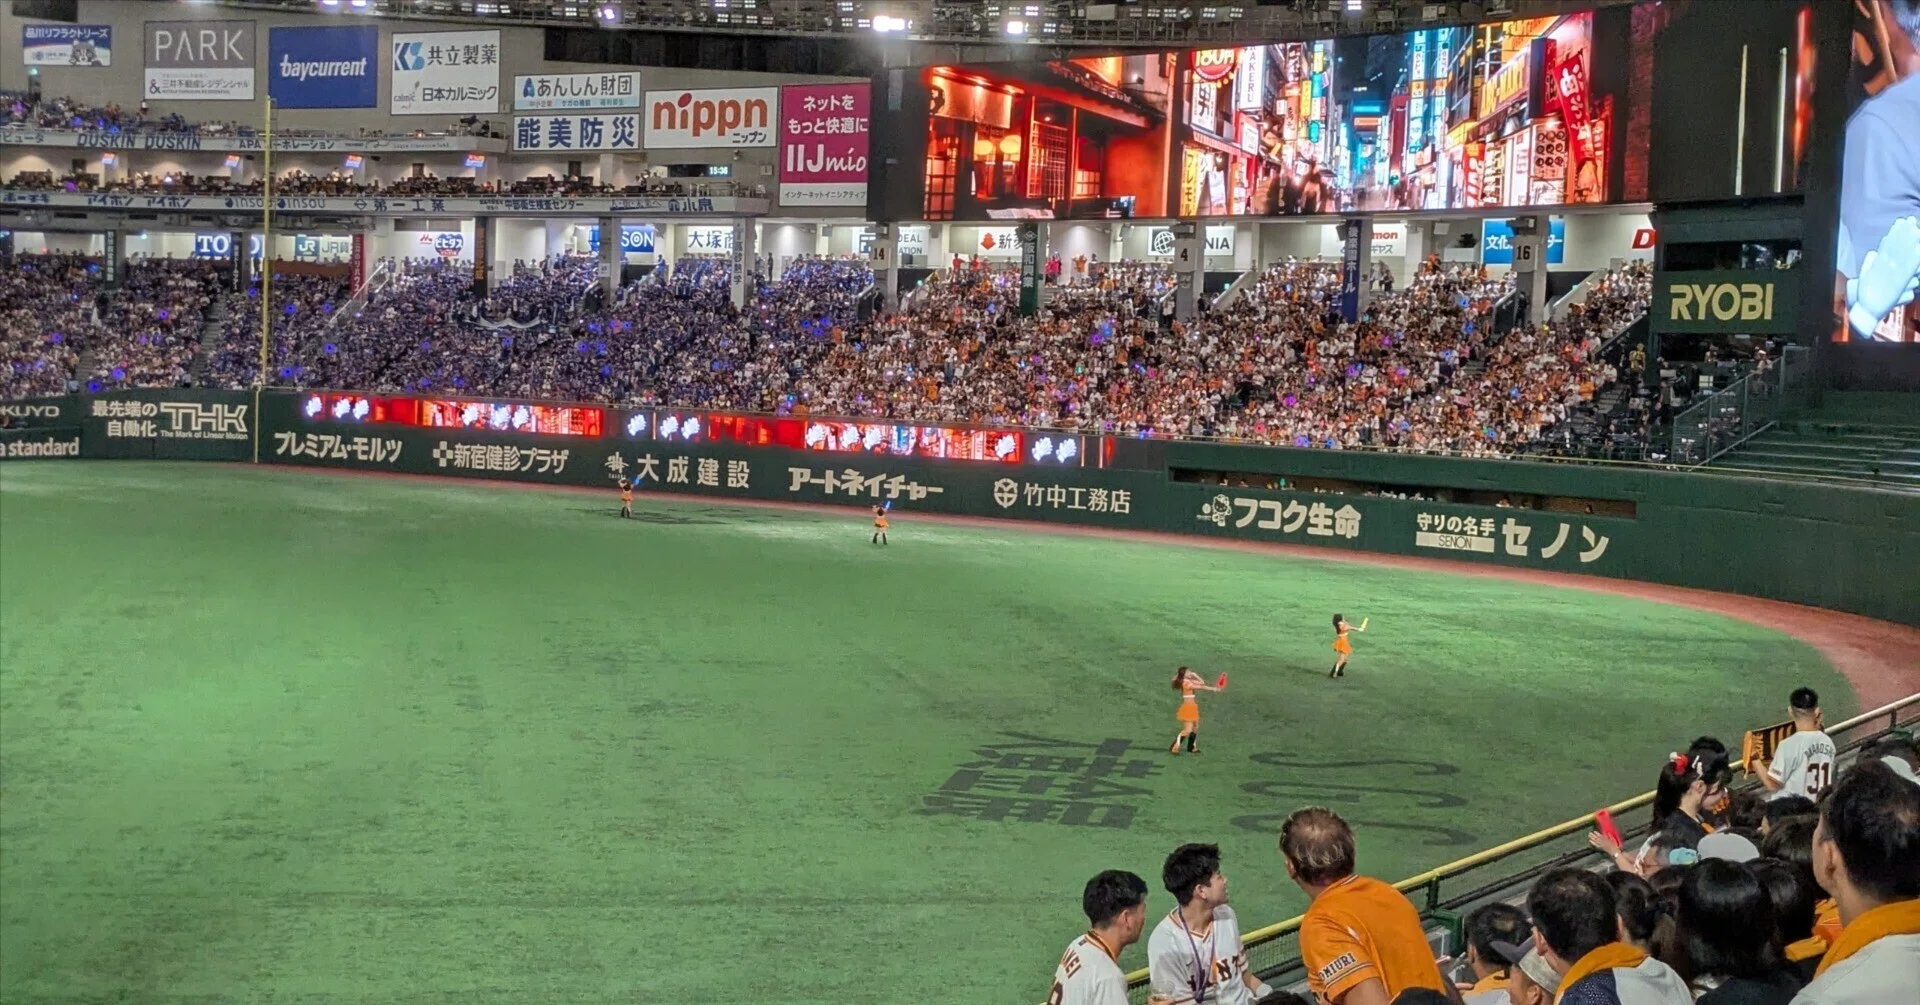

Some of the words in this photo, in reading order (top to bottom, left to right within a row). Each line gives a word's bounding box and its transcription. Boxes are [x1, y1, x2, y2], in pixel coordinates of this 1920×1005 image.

[25, 28, 108, 38] 品川リフラクトリーズ
[155, 29, 244, 61] PARK
[428, 44, 497, 66] 共立製薬
[280, 54, 367, 81] baycurrent
[422, 86, 497, 102] 日本カルミック
[537, 75, 632, 97] あんしん財団
[803, 94, 854, 112] ネットを
[653, 92, 768, 137] nippn
[788, 117, 868, 134] もっと快適に
[77, 133, 136, 148] DUSKIN
[144, 134, 200, 149] DUSKIN
[517, 116, 635, 149] 能美防災
[732, 131, 767, 144] ニップン
[873, 248, 885, 260] 14
[1180, 248, 1188, 262] 4
[1516, 246, 1531, 260] 16
[1670, 283, 1775, 321] RYOBI
[0, 405, 60, 418] KUYO
[92, 400, 157, 418] 最先端の
[160, 402, 249, 432] THK
[9, 437, 80, 457] standard
[454, 442, 570, 474] 新宿健診プラザ
[637, 453, 750, 489] 大成建設
[788, 467, 944, 501] アートネイチャー
[1023, 482, 1131, 515] 竹中工務店
[1233, 497, 1362, 540] フコク生命
[1417, 512, 1496, 537] 守りの名手
[1438, 535, 1472, 549] SENON
[1502, 518, 1609, 563] セノン
[1807, 762, 1830, 795] 31
